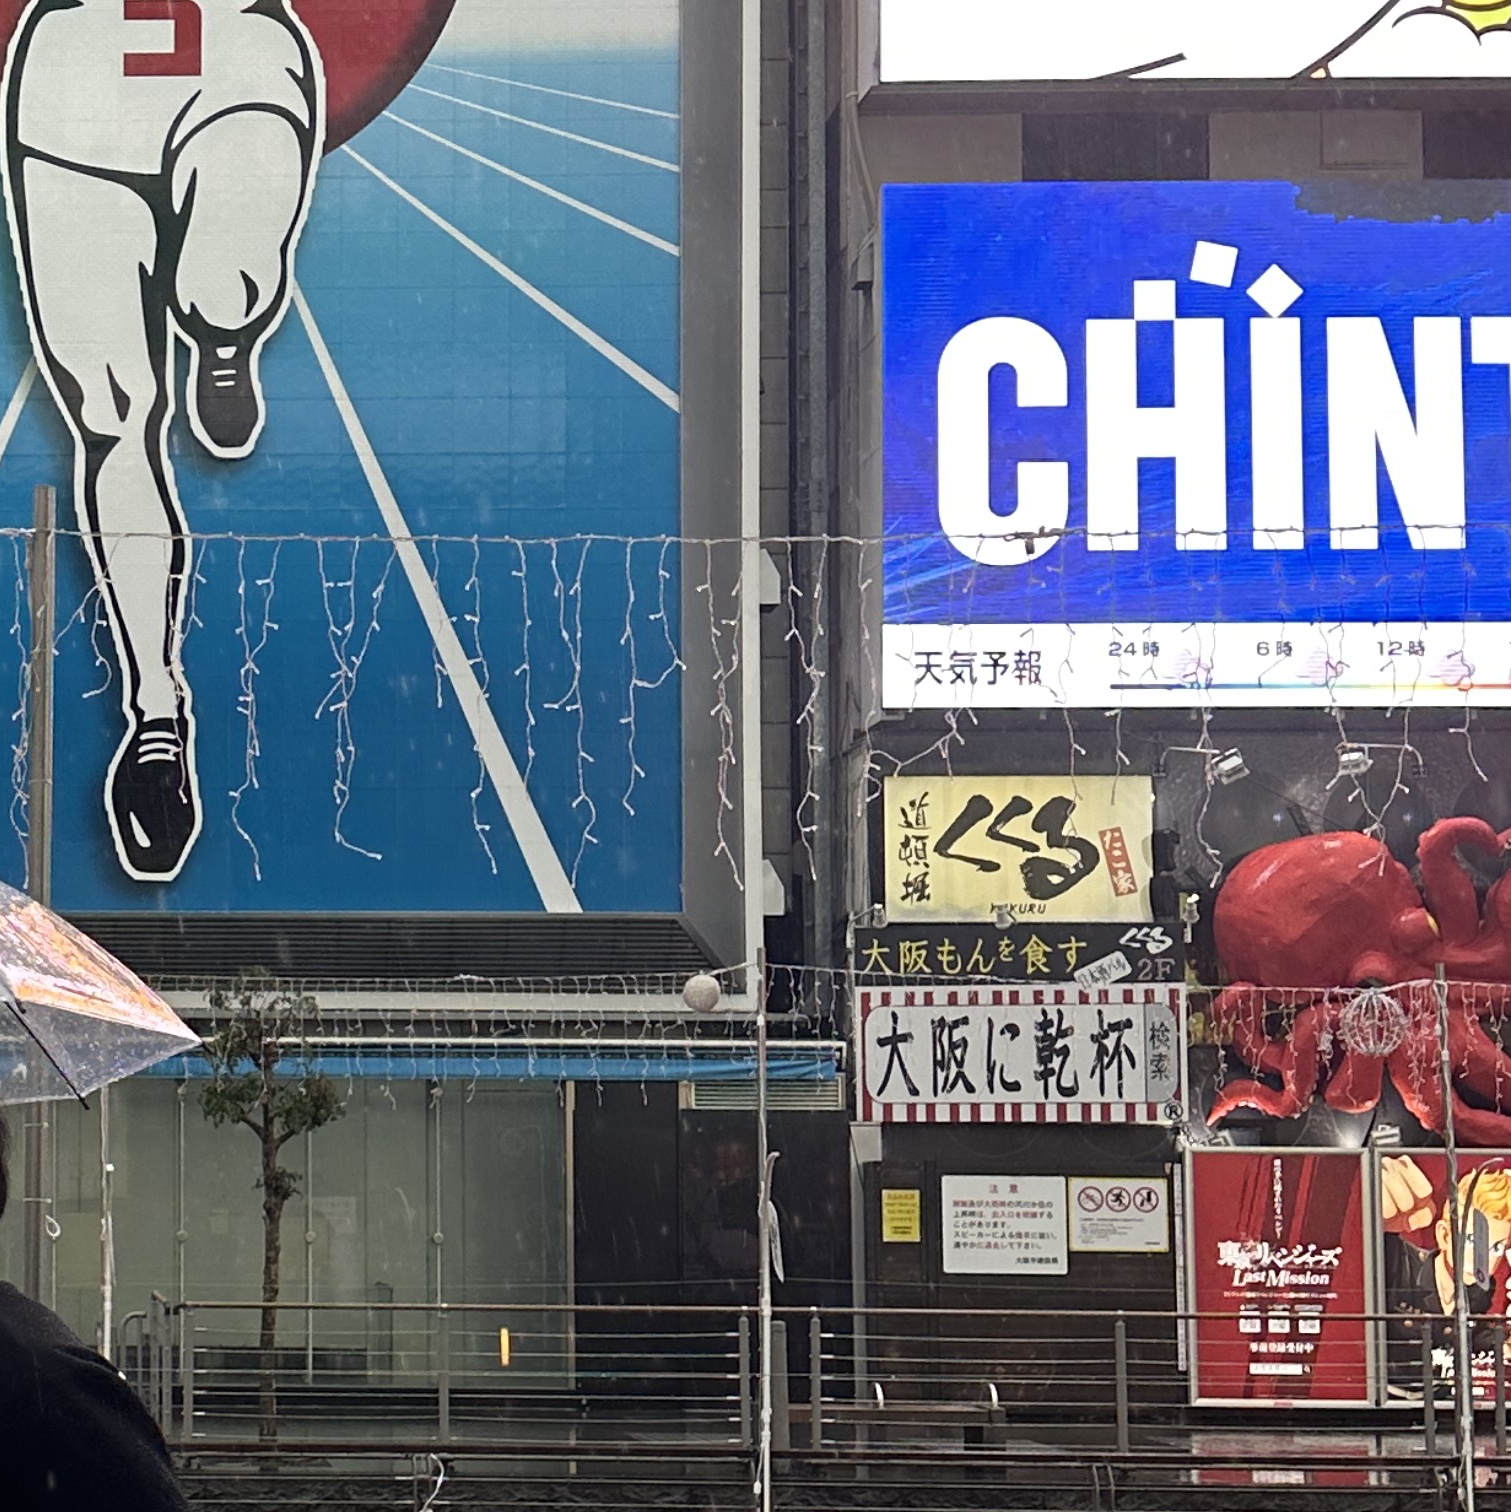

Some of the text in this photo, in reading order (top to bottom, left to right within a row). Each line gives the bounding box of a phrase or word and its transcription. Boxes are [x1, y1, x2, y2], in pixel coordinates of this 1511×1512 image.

[913, 650, 1043, 686] 天気予報
[897, 791, 933, 906] 道頓堀
[932, 794, 1101, 901] くくる
[1101, 830, 1137, 897] たこ家
[860, 934, 1088, 976] 大阪もんを食す
[1137, 958, 1176, 981] 2F
[876, 1008, 1137, 1100] 大阪に乾杯
[1149, 1020, 1173, 1082] 検索
[1232, 1269, 1330, 1287] Last Mission
